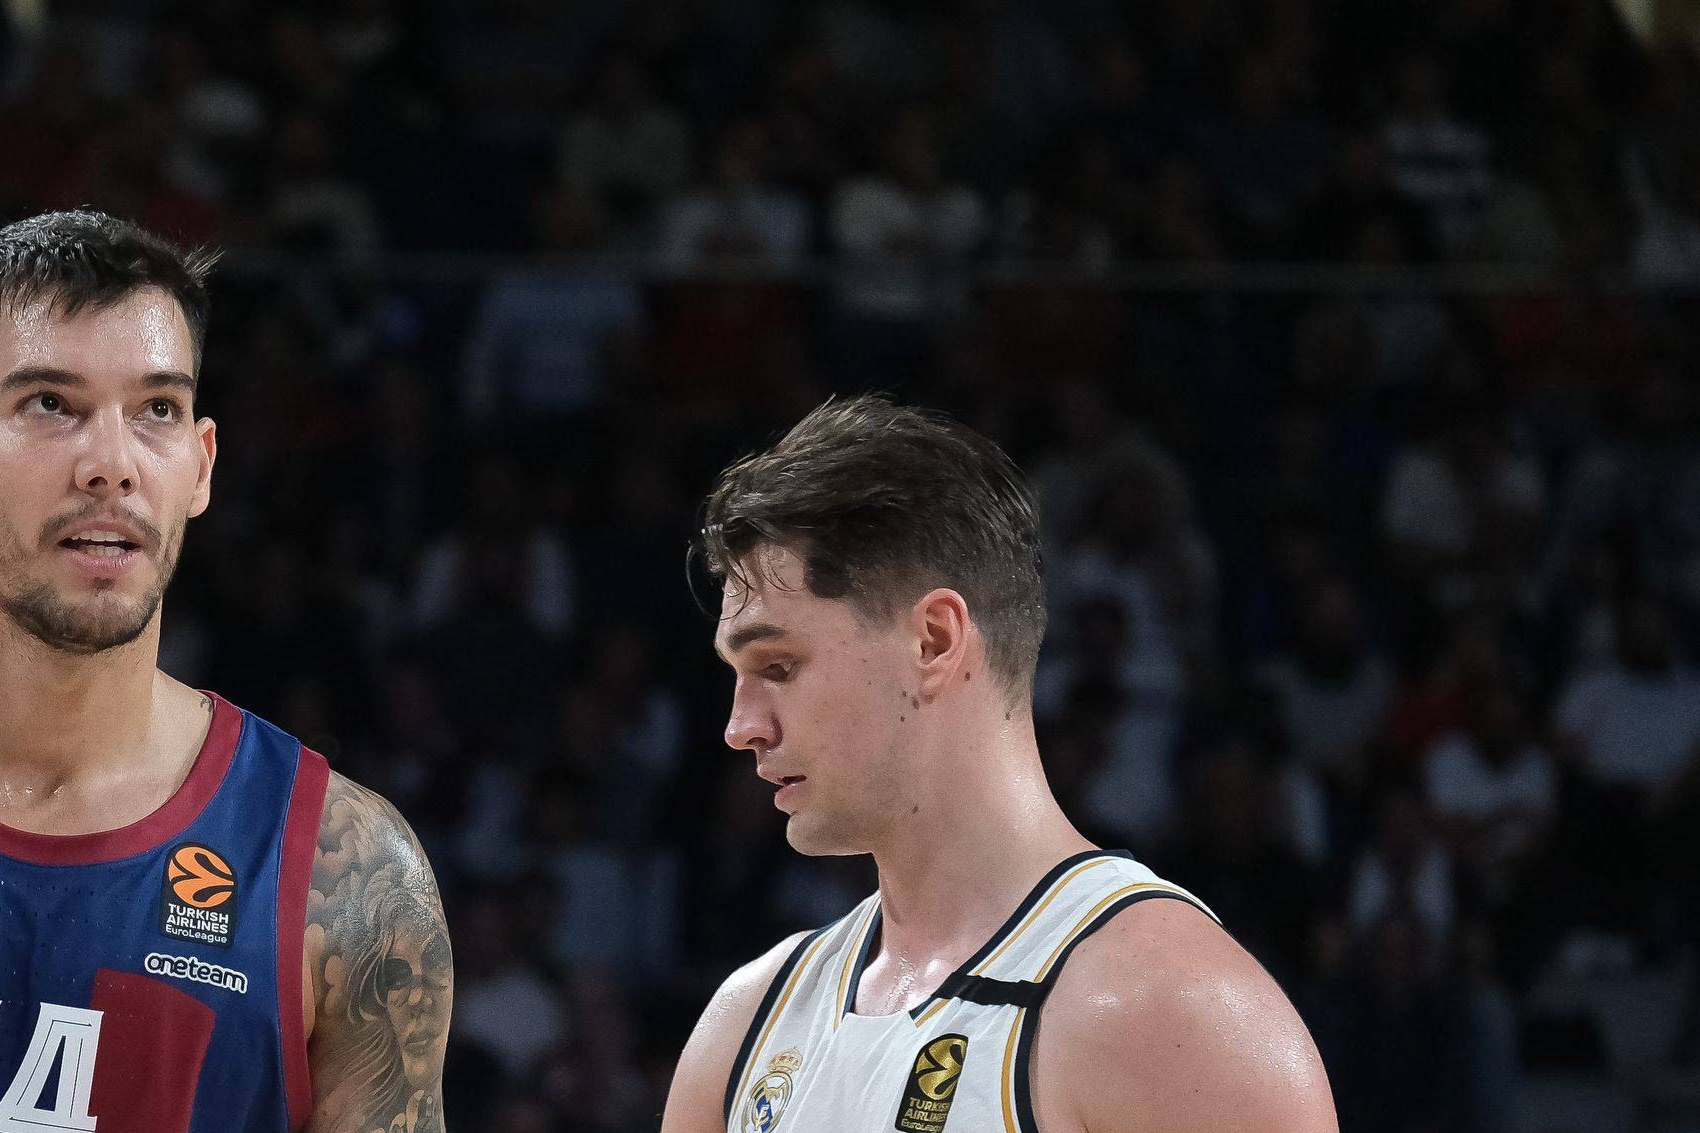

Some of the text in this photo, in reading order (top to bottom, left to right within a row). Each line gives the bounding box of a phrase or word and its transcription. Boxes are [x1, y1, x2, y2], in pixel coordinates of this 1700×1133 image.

[168, 903, 229, 924] TURKISH
[165, 924, 228, 943] EuroLeague
[166, 914, 228, 934] AIRLINES
[146, 954, 247, 993] oneteam
